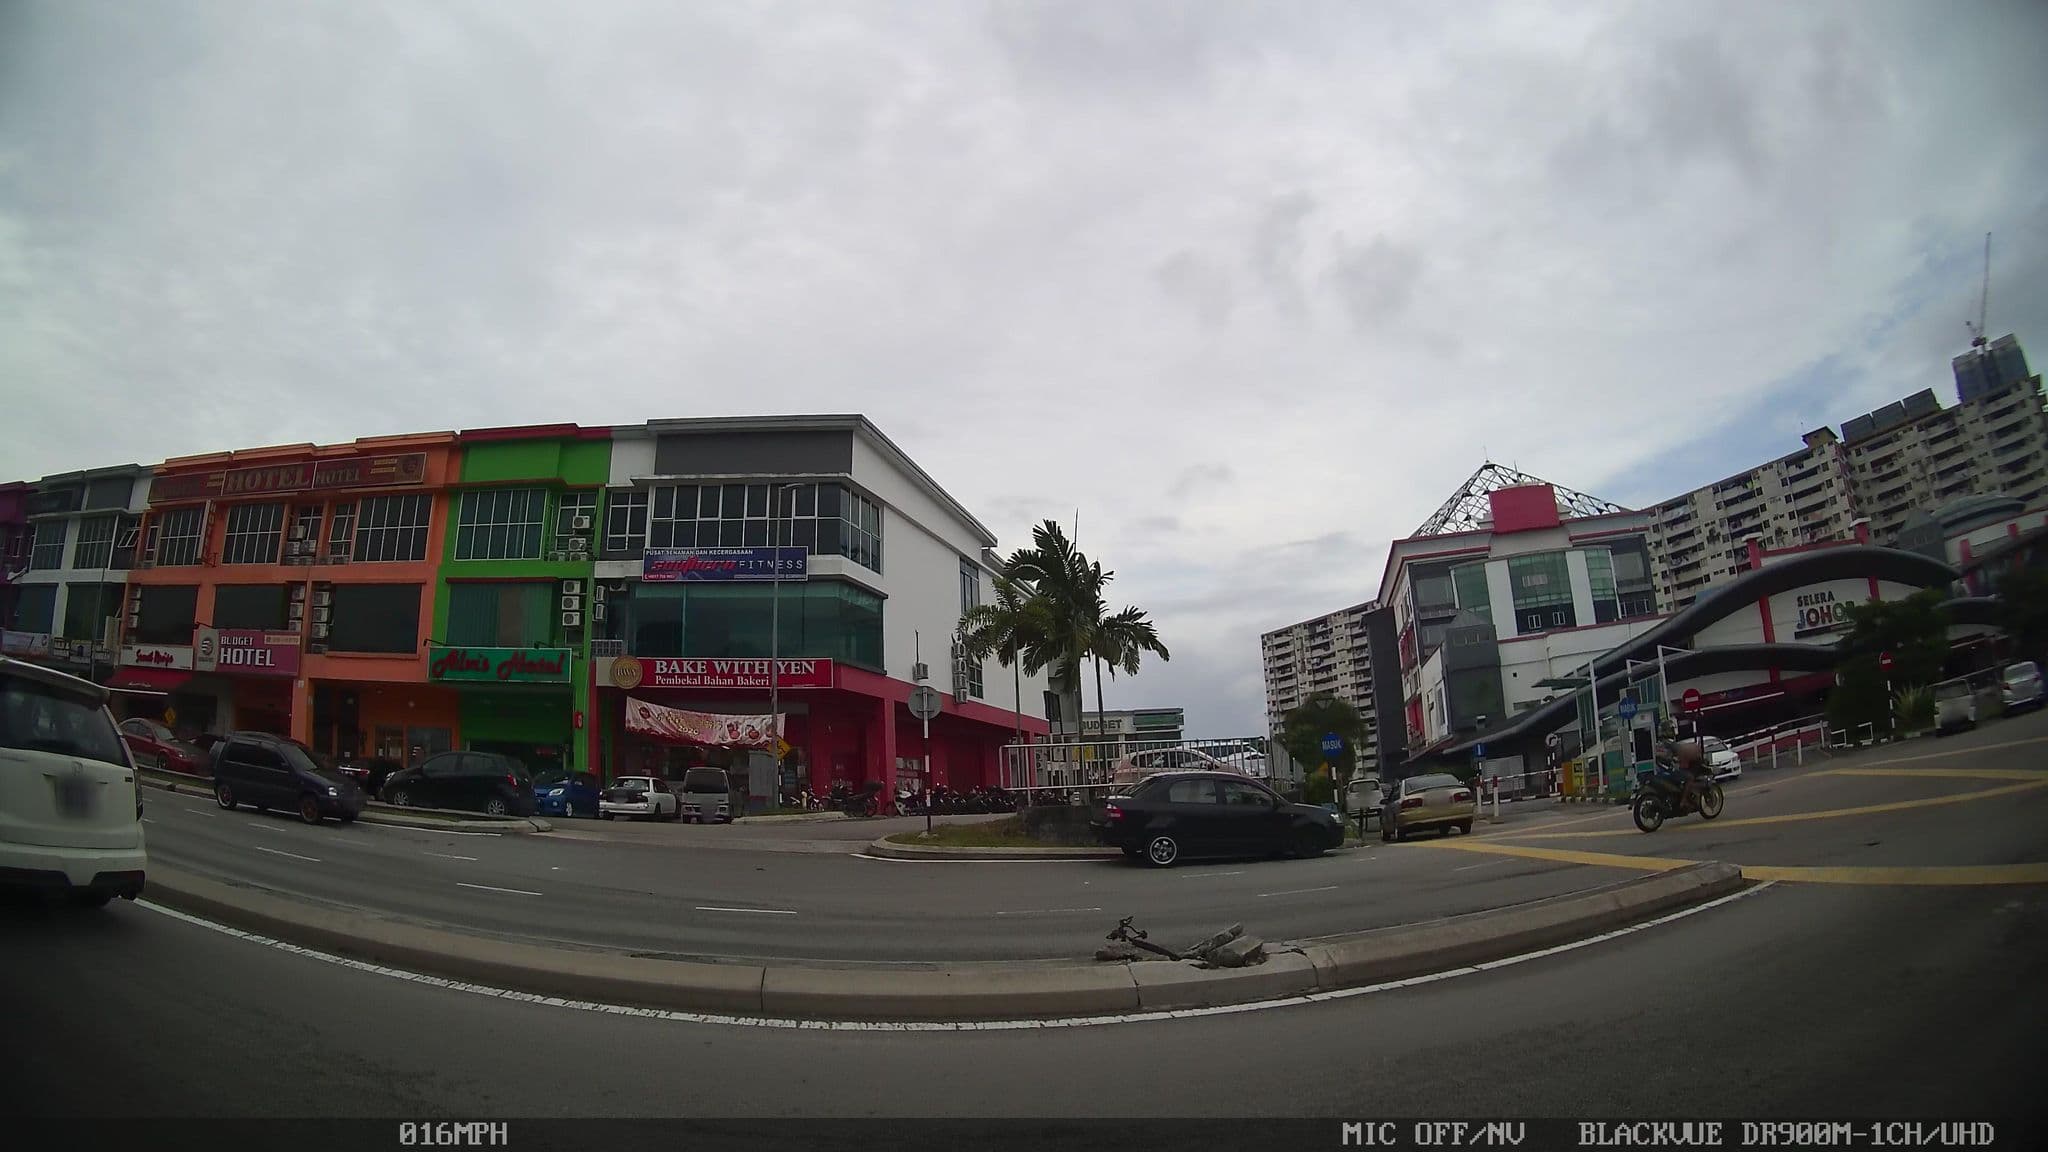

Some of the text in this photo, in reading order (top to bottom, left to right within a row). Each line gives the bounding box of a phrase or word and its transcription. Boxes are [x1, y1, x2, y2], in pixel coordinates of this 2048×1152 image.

[739, 560, 803, 569] FITNESS
[1797, 591, 1835, 607] SELERA
[220, 636, 254, 646] BUDGET
[219, 648, 275, 666] HOTEL
[497, 651, 565, 680] Hotel
[655, 661, 816, 675] BAKE WITH YEN
[656, 676, 770, 686] Pembekal Bahan Bakeri
[1322, 740, 1344, 750] MASUK
